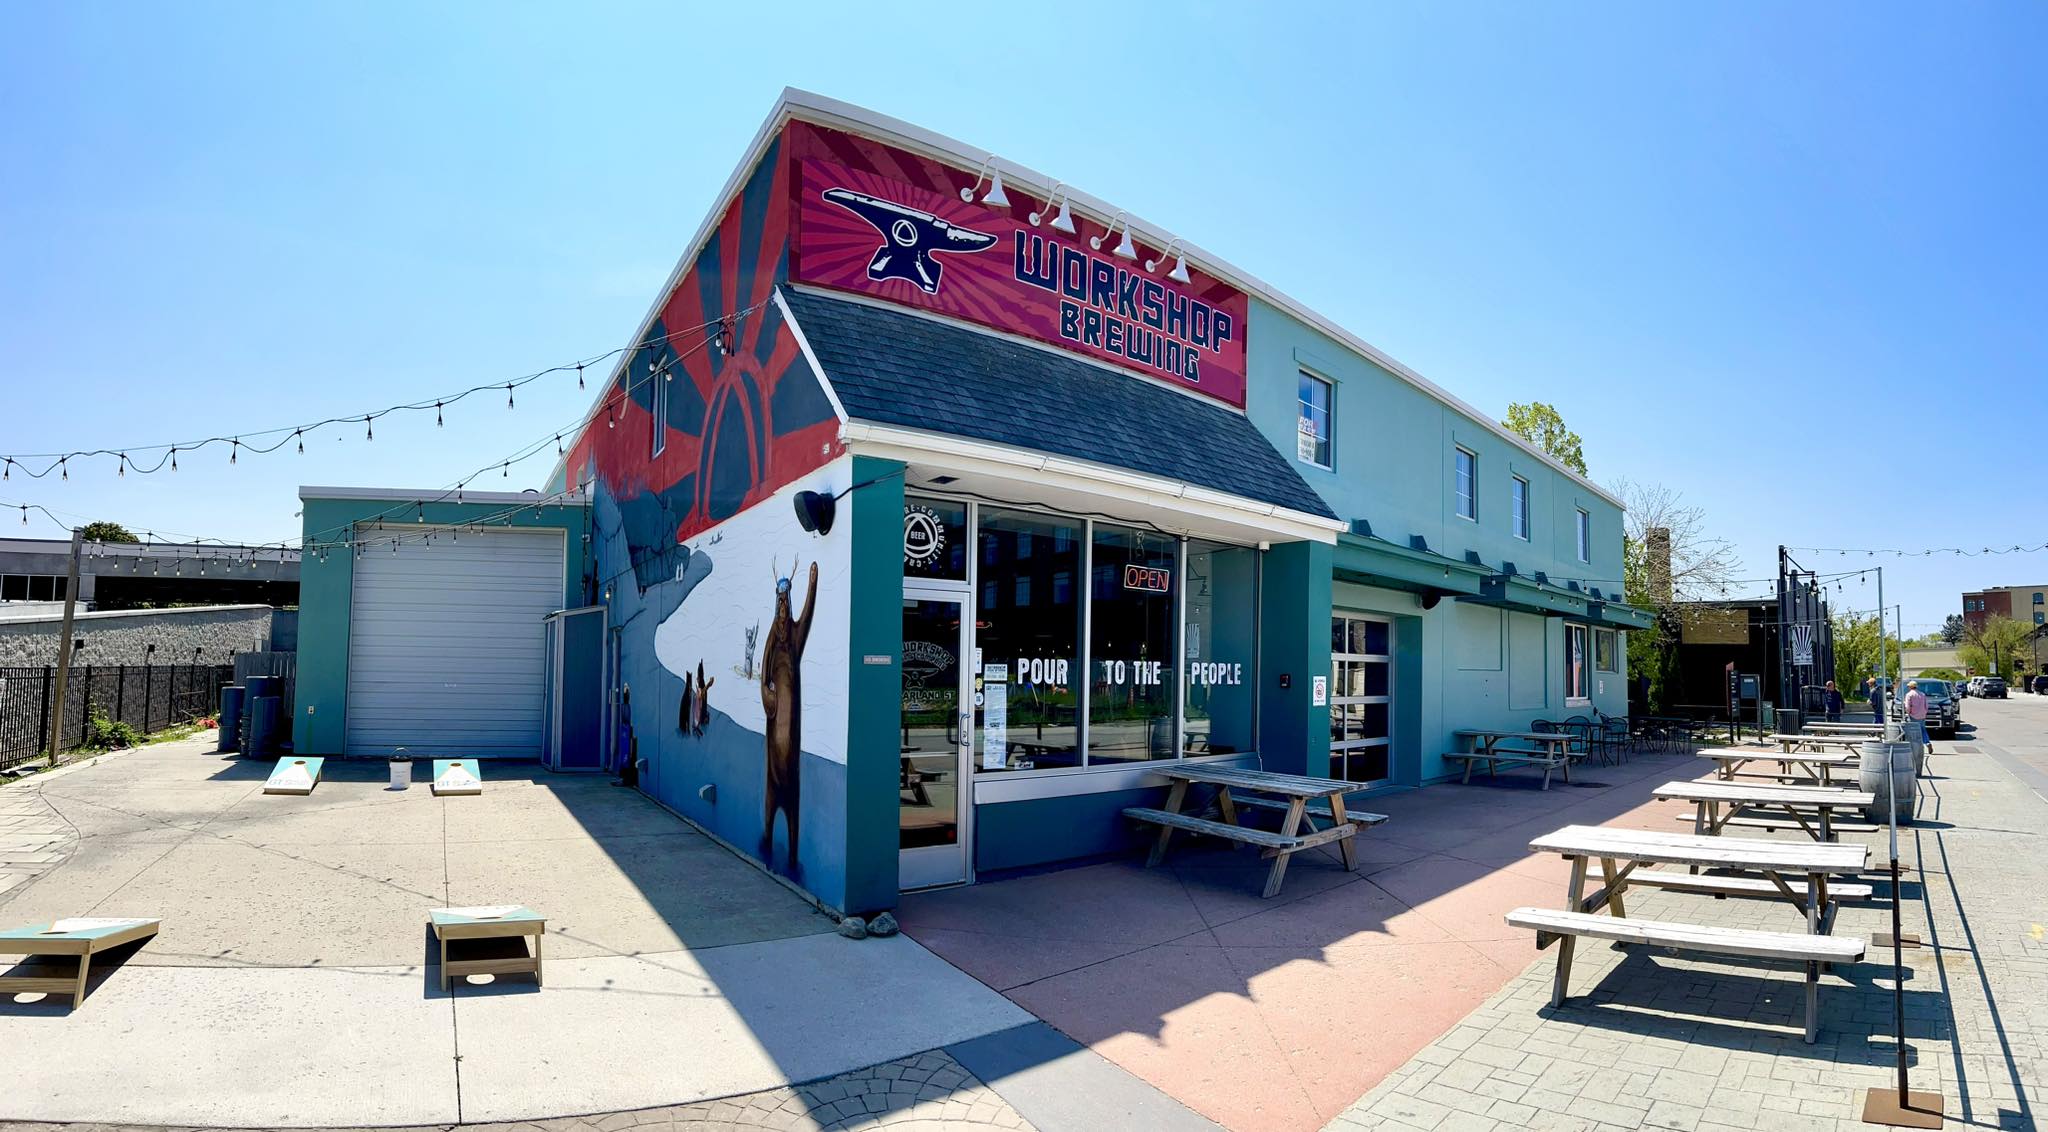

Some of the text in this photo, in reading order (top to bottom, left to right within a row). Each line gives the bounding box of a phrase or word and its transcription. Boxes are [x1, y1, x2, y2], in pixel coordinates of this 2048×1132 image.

[1014, 229, 1232, 354] WORKSHOP
[1059, 300, 1201, 383] BREWING
[910, 531, 926, 540] BEER
[1126, 567, 1168, 590] OPEN
[1018, 658, 1241, 685] POUR TO THE PEOPLE
[902, 690, 941, 700] ARLAND
